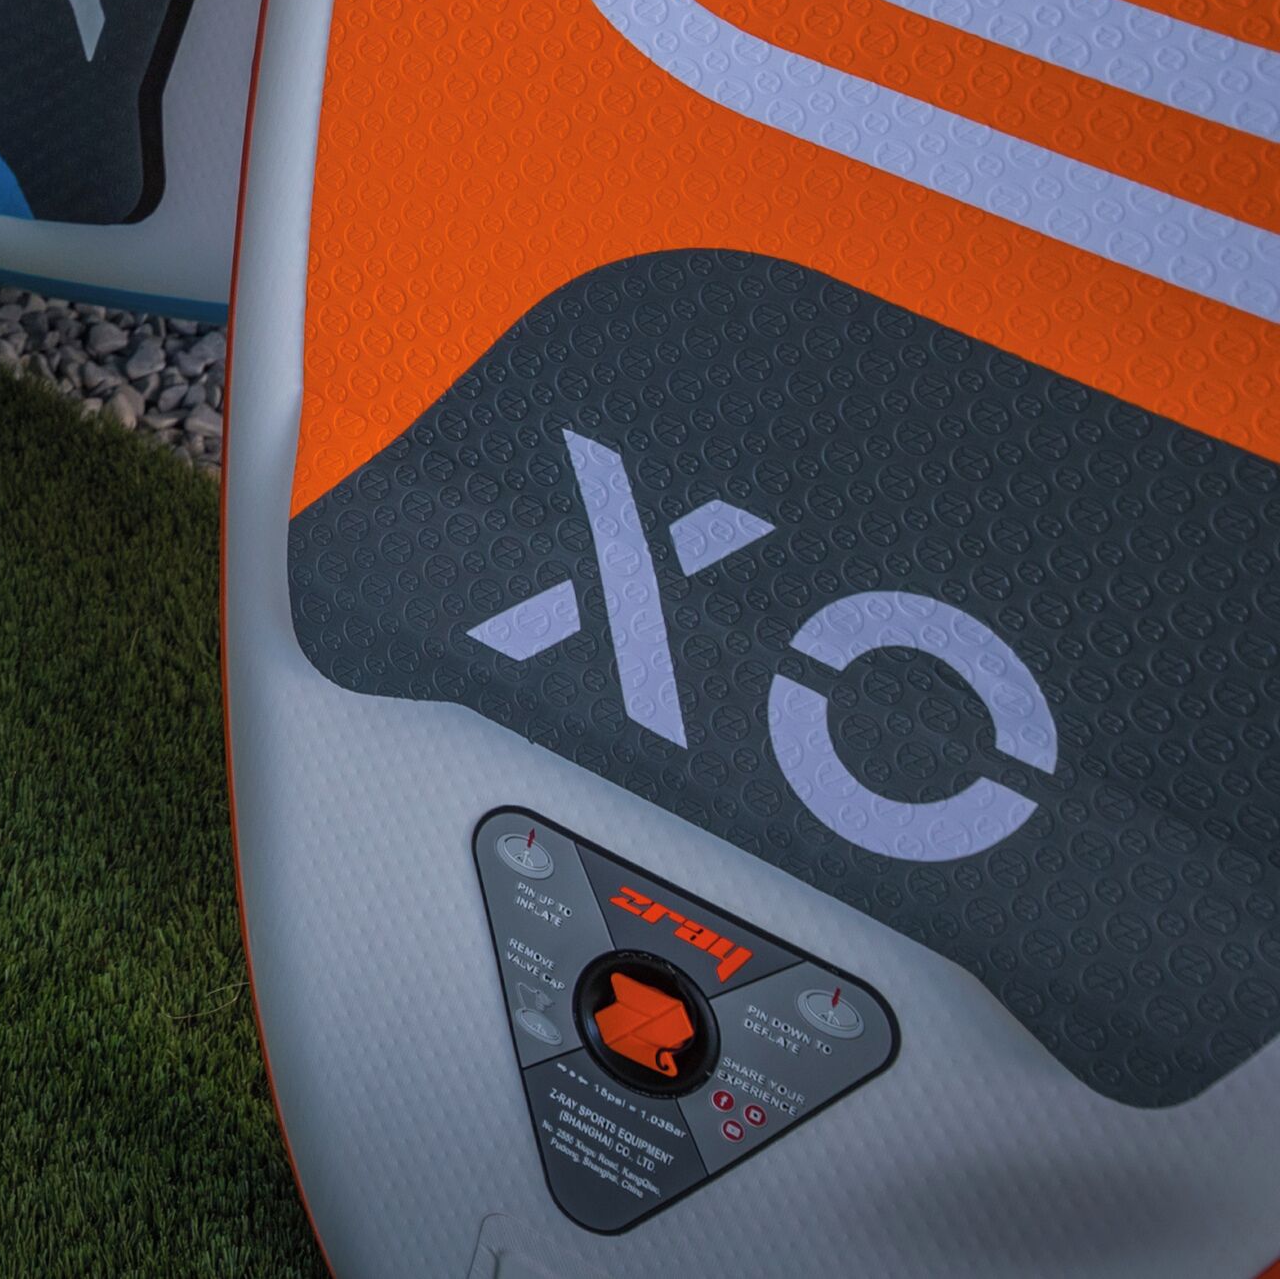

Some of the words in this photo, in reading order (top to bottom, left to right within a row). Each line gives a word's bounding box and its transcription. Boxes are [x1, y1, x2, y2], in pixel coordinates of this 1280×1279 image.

[516, 896, 562, 927] INFLATE
[517, 882, 535, 898] PIN
[539, 894, 555, 906] UP
[559, 903, 572, 917] TO
[509, 938, 555, 970] REMOVE
[608, 886, 753, 984] zray
[507, 952, 540, 976] VALVE
[543, 973, 565, 990] CAP
[744, 1018, 801, 1054] DEFLATE
[748, 1005, 769, 1022] PIN
[772, 1017, 811, 1044] DOWN
[816, 1040, 832, 1055] TO
[717, 1069, 798, 1117] EXPERIENCE
[723, 1057, 766, 1084] SHARE
[770, 1080, 805, 1105] YOUR
[549, 1088, 578, 1110] Z-RAY
[578, 1105, 617, 1134] SPORTS
[617, 1128, 674, 1166] EQUIPMENT
[559, 1110, 614, 1150] (SHANGHAI)
[621, 1180, 643, 1199] China
